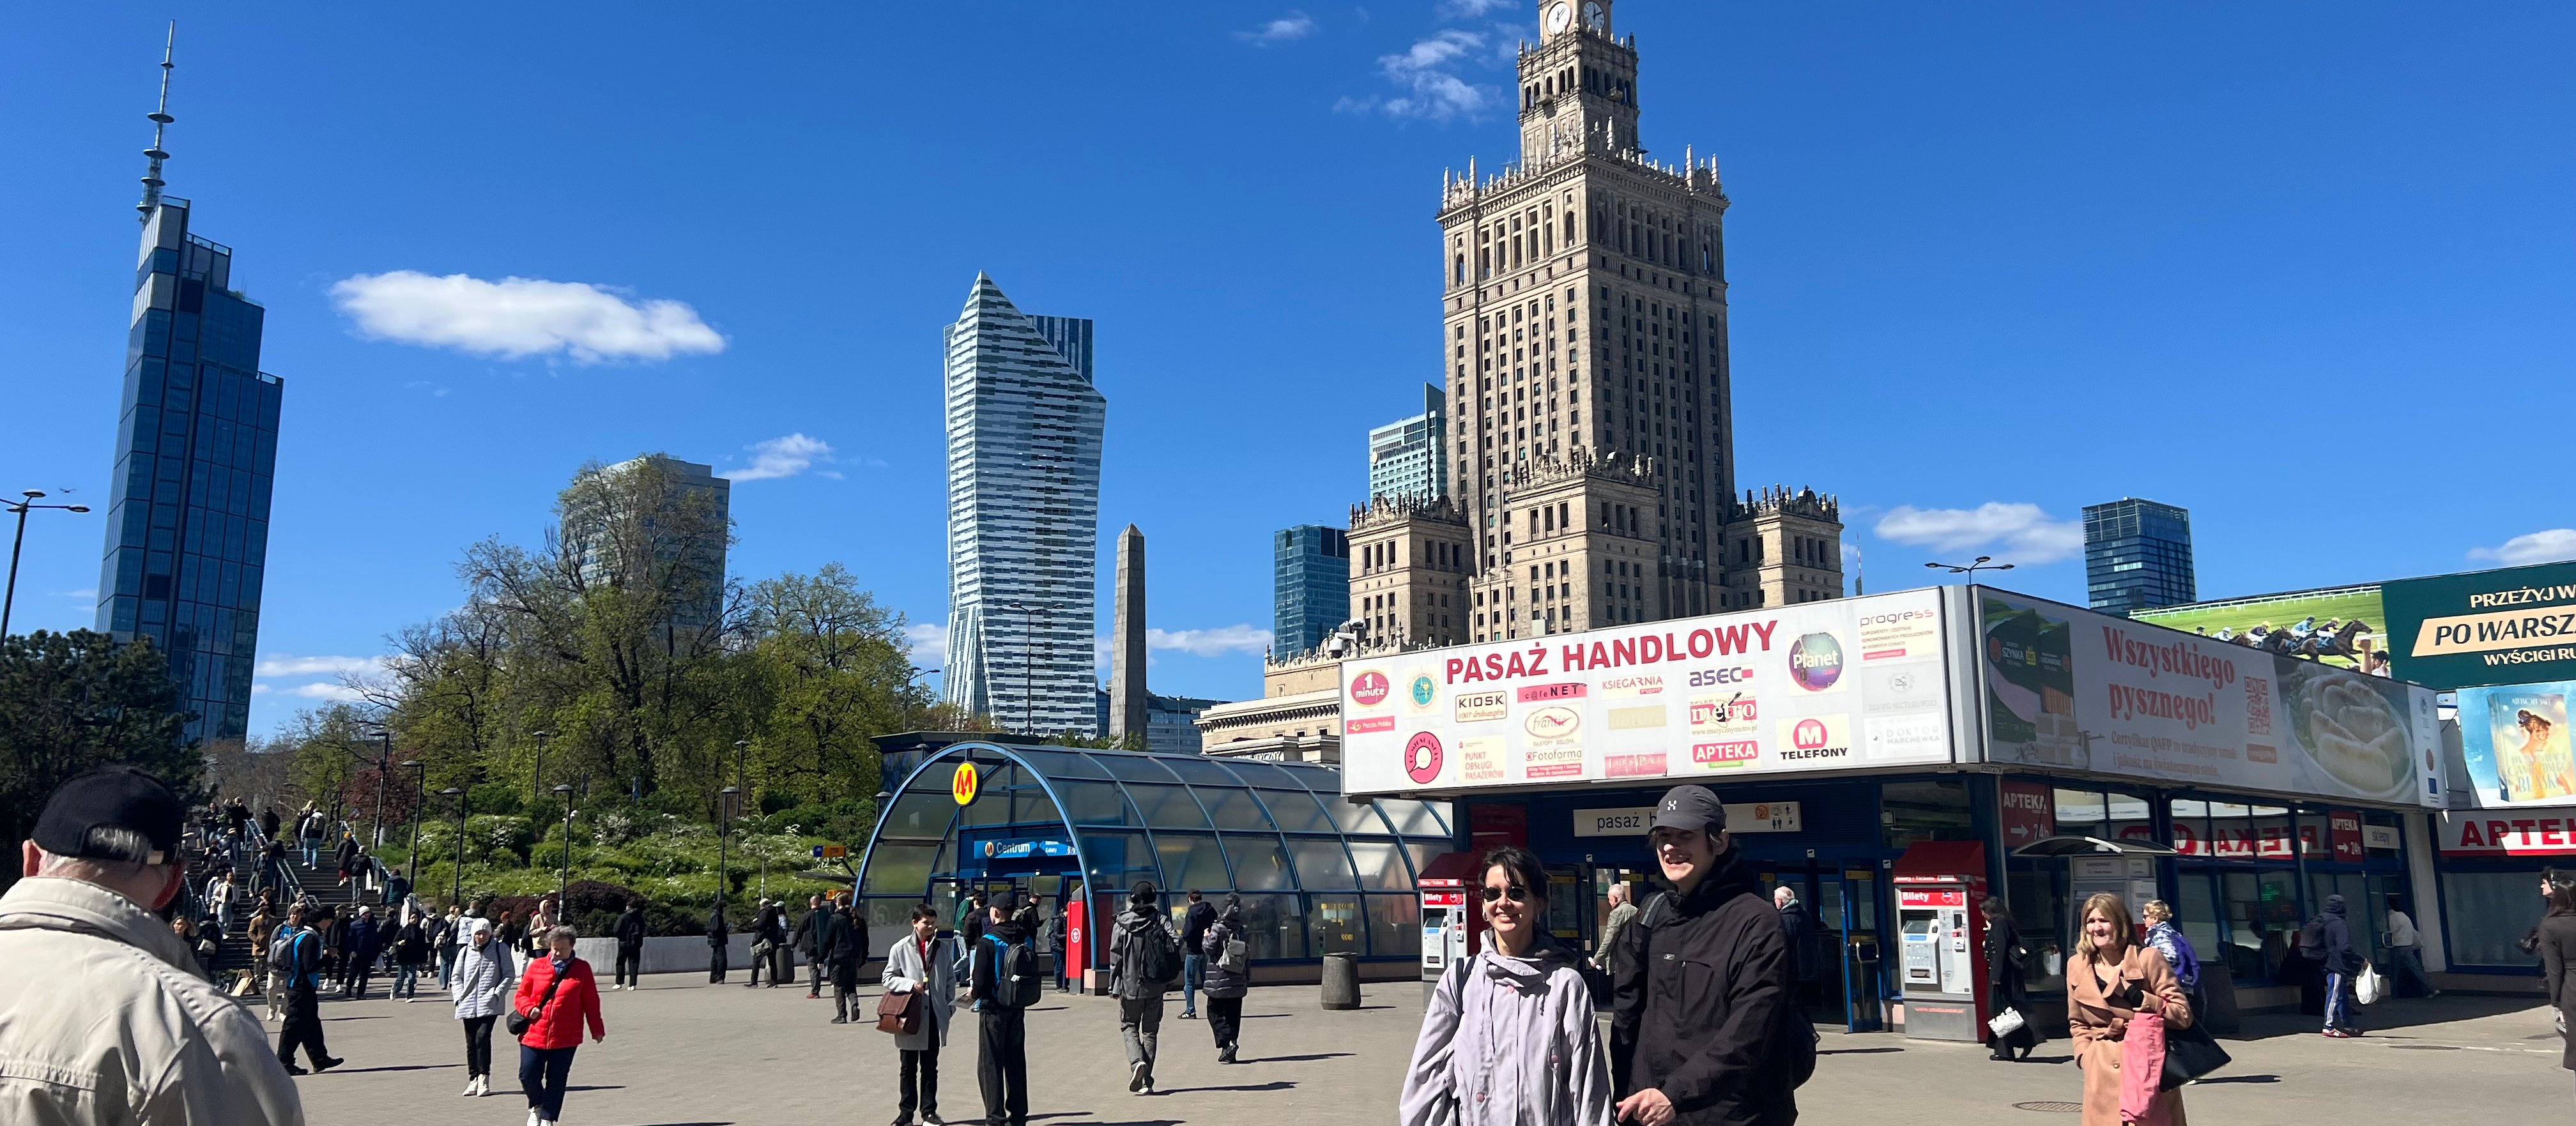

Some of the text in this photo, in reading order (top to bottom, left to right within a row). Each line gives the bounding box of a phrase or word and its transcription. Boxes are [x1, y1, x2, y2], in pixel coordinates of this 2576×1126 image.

[2470, 586, 2554, 608] PRZEŻYJ
[1860, 609, 1934, 628] progress
[2435, 613, 2576, 646] PO WARSZ
[1446, 620, 1777, 685] PASAŻ HANDLOWY
[1793, 650, 1839, 669] Planet
[2002, 647, 2024, 660] SZYNKA
[2102, 626, 2235, 690] Wszystkiego
[2483, 649, 2555, 666] WYŚCIGI
[1365, 673, 1373, 689] 1
[1602, 676, 1663, 690] KSIĘGARNIA
[1689, 667, 1742, 687] asec
[1356, 688, 1384, 698] minute
[1459, 695, 1504, 708] KIOSK
[1690, 703, 1756, 722] metro
[2108, 683, 2216, 730] pysznego!
[1798, 726, 1823, 745] M
[1887, 735, 1940, 744] MARCHEWKA
[2111, 731, 2149, 749] Certyfikat
[1465, 752, 1487, 760] PUNKT
[1533, 749, 1582, 761] Fotoforma
[1696, 743, 1756, 761] APTEKA
[1781, 747, 1848, 760] TELEFONY
[1465, 761, 1492, 770] OBSŁUGI
[1465, 768, 1504, 780] PASAŻERÓW
[956, 770, 972, 797] M
[2004, 792, 2047, 810] APTEKA
[1597, 812, 1640, 832] pasaż
[2332, 818, 2358, 832] APTEKA
[997, 842, 1031, 854] Centrum
[1425, 893, 1443, 903] Bilety
[1902, 892, 1929, 902] Bilety
